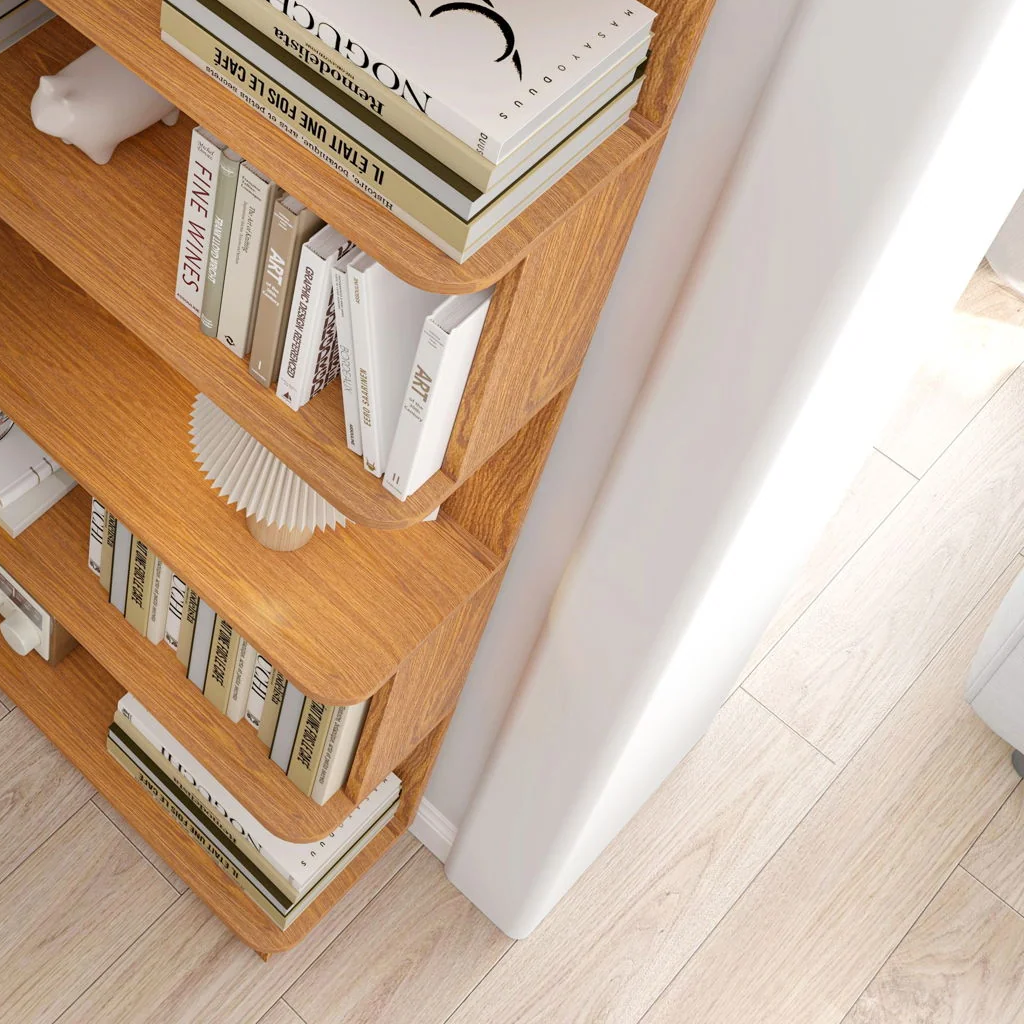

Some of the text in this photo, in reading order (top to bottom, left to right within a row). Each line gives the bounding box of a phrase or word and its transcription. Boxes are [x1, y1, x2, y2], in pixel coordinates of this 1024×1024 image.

[205, 65, 239, 93] secrets
[273, 26, 385, 117] Remodelista
[499, 9, 634, 120] MASAYO DUUS
[213, 46, 385, 186] IL ÉTAIT UNE FOIS LE CAFÉ
[264, 112, 278, 124] et
[278, 121, 300, 139] arts
[476, 132, 489, 155] DUUS
[352, 174, 394, 211] Histoire,
[182, 160, 213, 293] FINE WINES
[207, 216, 224, 285] FRANK LLOYD WRIGHT
[266, 247, 286, 286] ART
[286, 266, 315, 379] GRAPHIC DESIGN REFERENCED
[340, 344, 353, 393] BORDEAUX
[359, 368, 371, 407] SAARINEN
[411, 364, 433, 403] ART
[251, 655, 273, 701] UCHI
[161, 746, 263, 854] NOGUCHI
